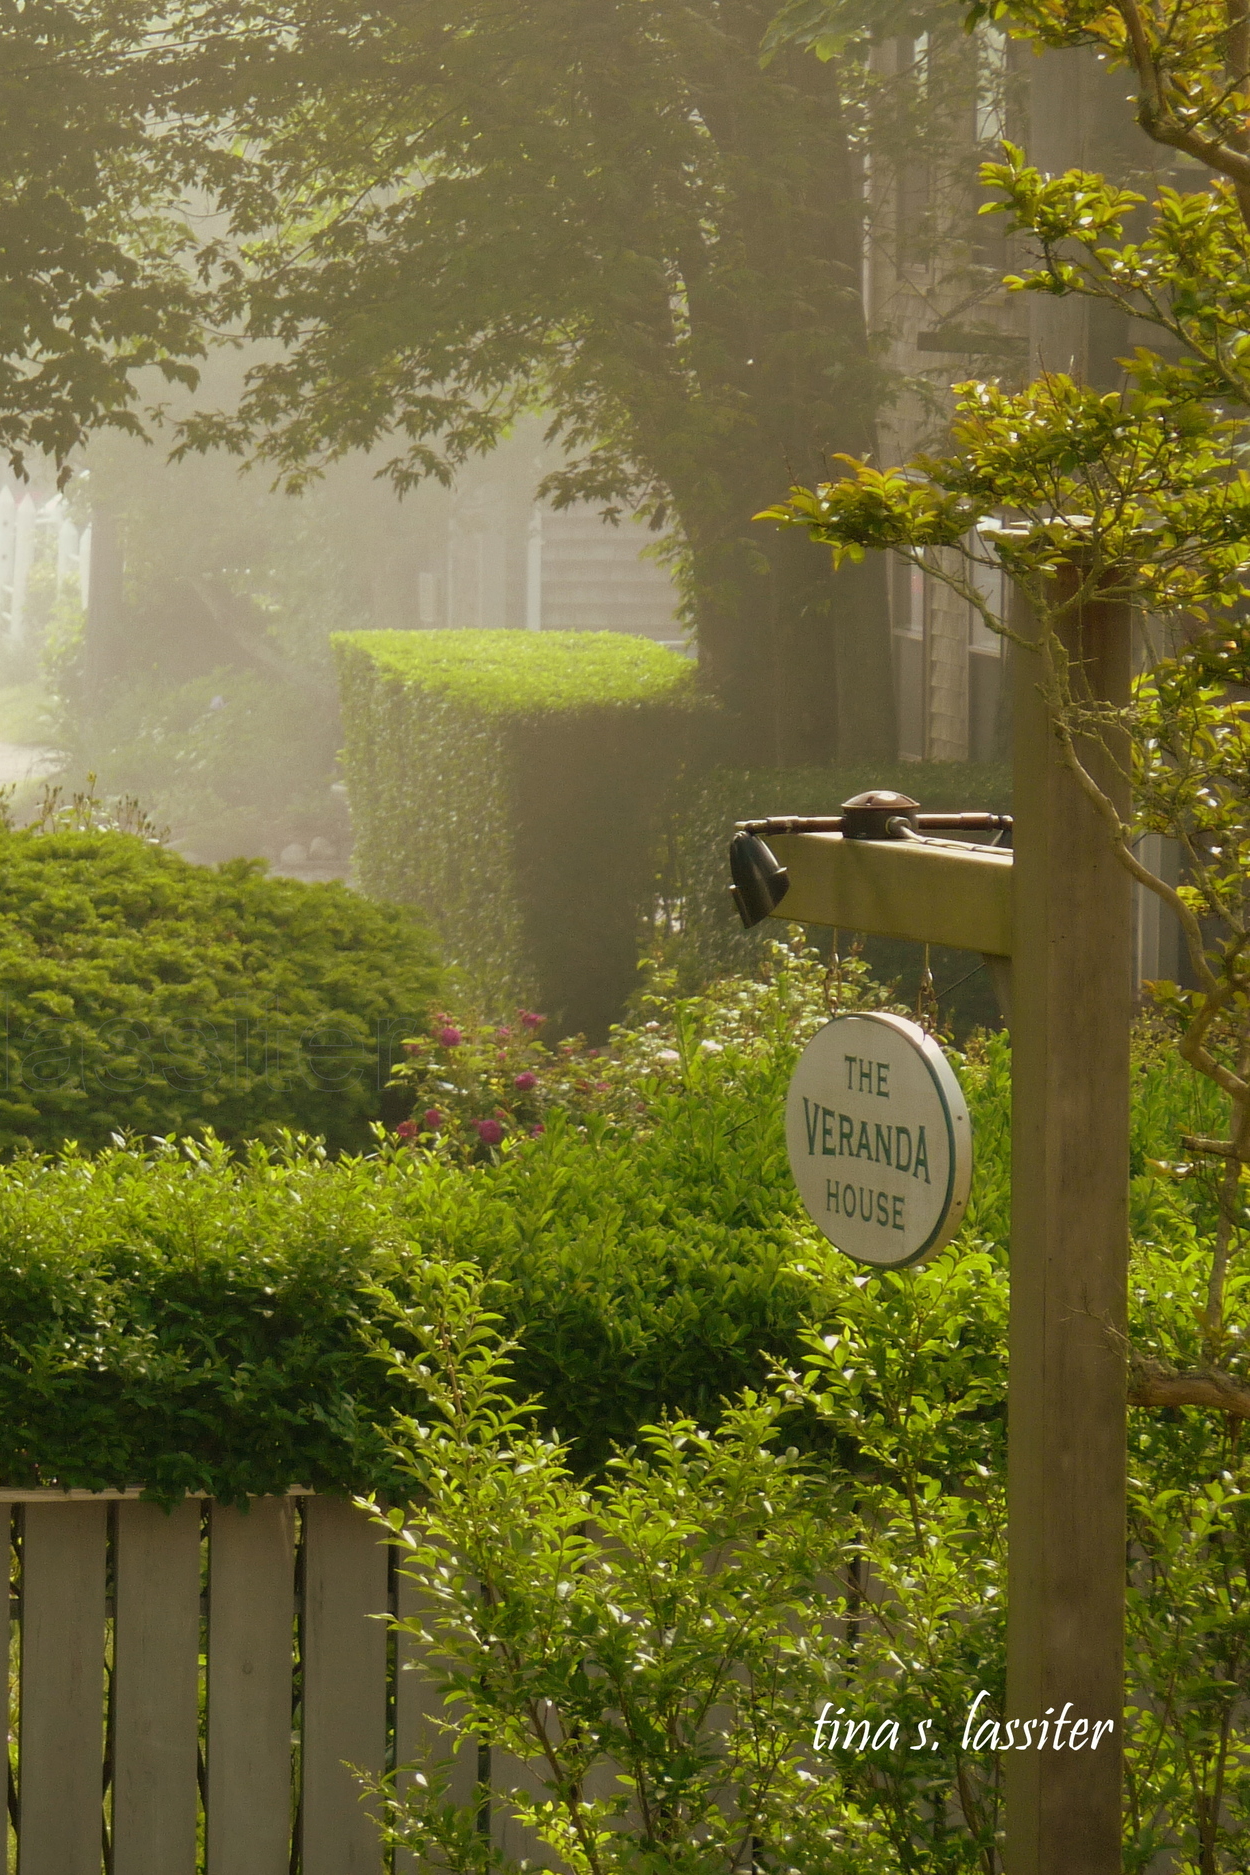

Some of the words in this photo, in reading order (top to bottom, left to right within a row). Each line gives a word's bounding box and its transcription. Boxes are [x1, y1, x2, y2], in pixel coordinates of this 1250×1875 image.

[845, 1054, 890, 1099] THE
[803, 1096, 931, 1185] VERANDA
[826, 1178, 905, 1232] HOUSE
